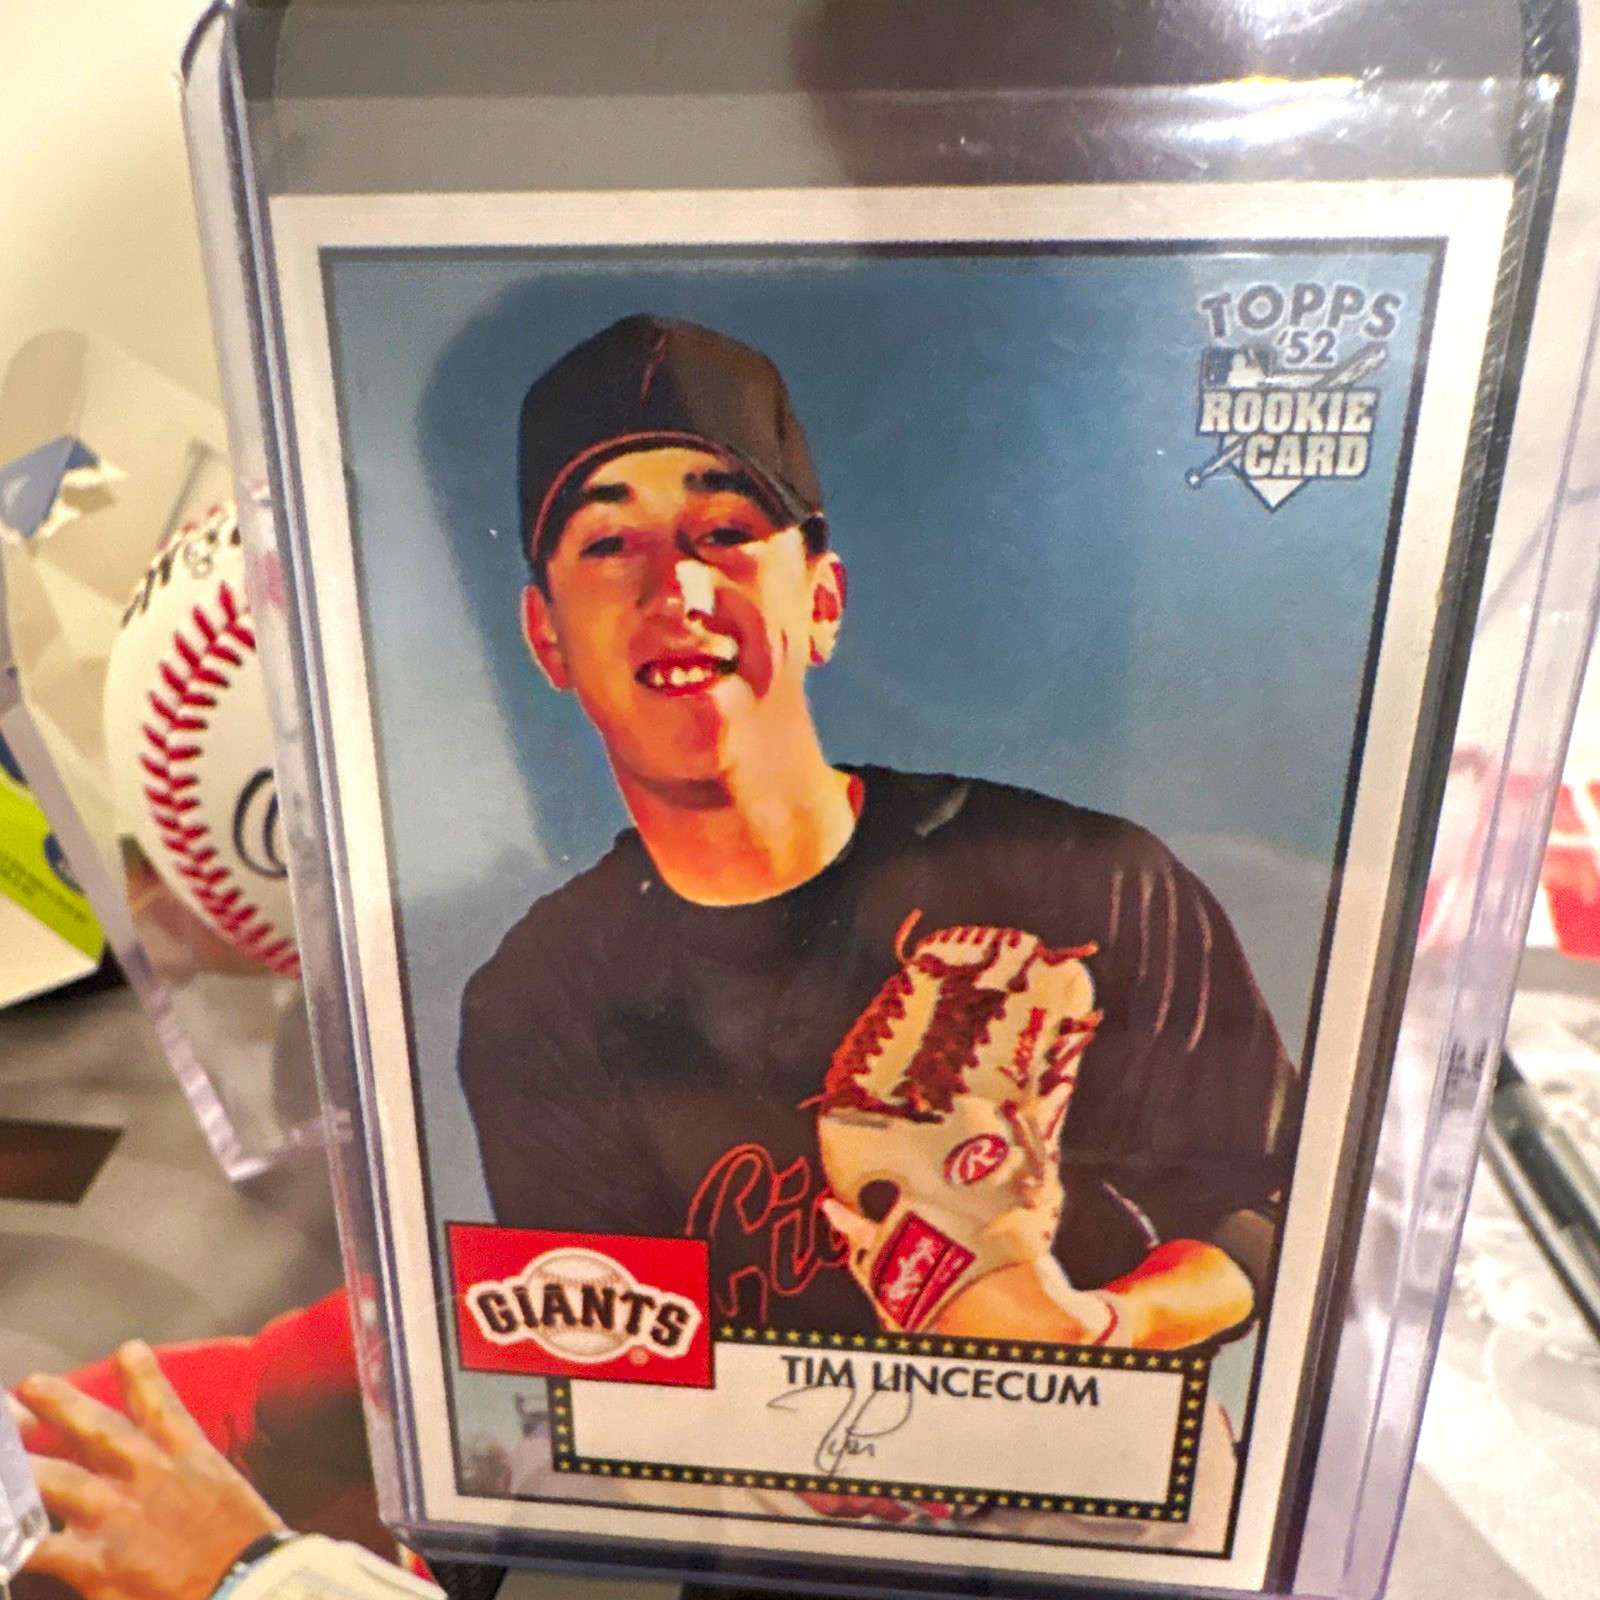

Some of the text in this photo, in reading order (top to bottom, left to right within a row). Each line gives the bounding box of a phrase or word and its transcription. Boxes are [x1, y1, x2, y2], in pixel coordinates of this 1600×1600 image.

[1200, 282, 1402, 339] TOPPS
[1276, 330, 1337, 365] '52
[1199, 390, 1377, 433] ROOKIE
[1244, 434, 1369, 477] CARD
[476, 1282, 691, 1347] GIANTS
[781, 1354, 1099, 1407] TIM LINCECUM
